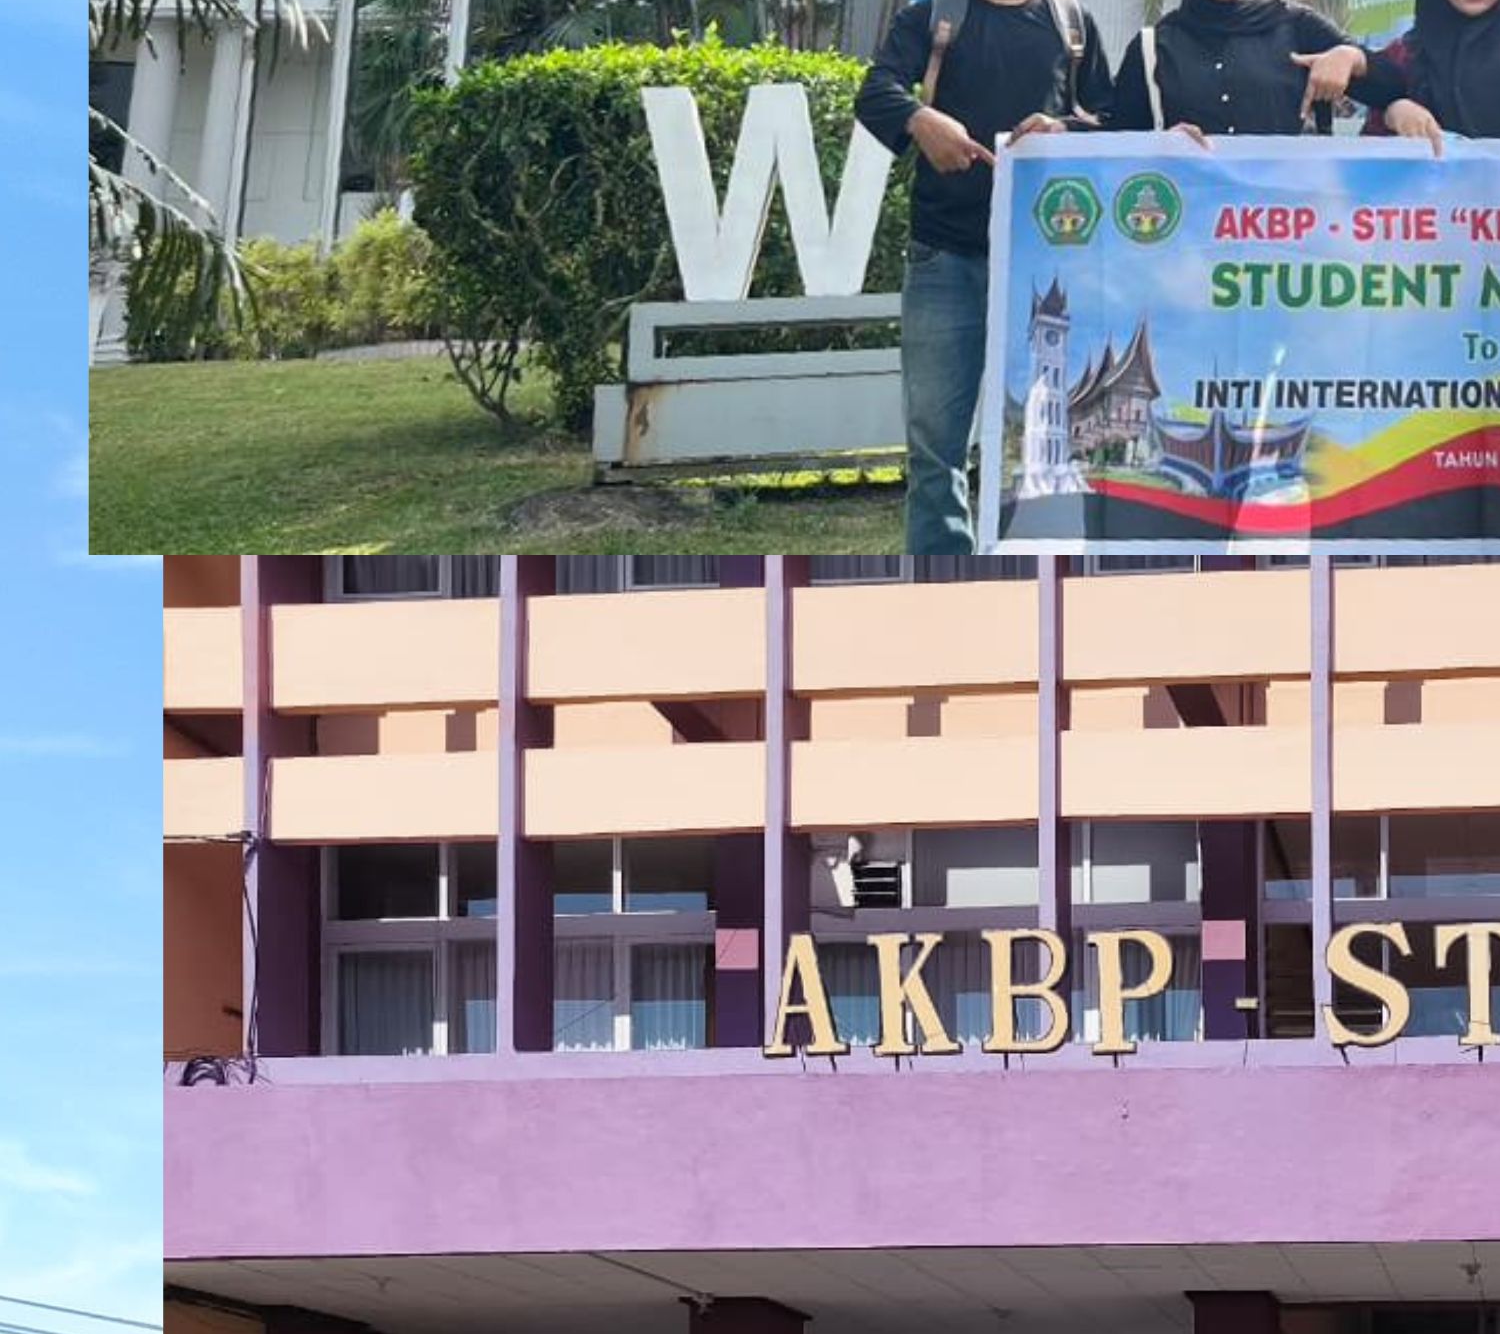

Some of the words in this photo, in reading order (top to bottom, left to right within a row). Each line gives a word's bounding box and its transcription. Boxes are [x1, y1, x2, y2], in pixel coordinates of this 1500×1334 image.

[1214, 207, 1315, 240] AKBP
[1352, 208, 1437, 241] STIE
[1211, 262, 1461, 308] STUDENT
[1463, 332, 1498, 360] To
[1195, 379, 1263, 409] INTI
[1434, 451, 1498, 468] TAHUN
[763, 929, 1174, 1058] AKBP
